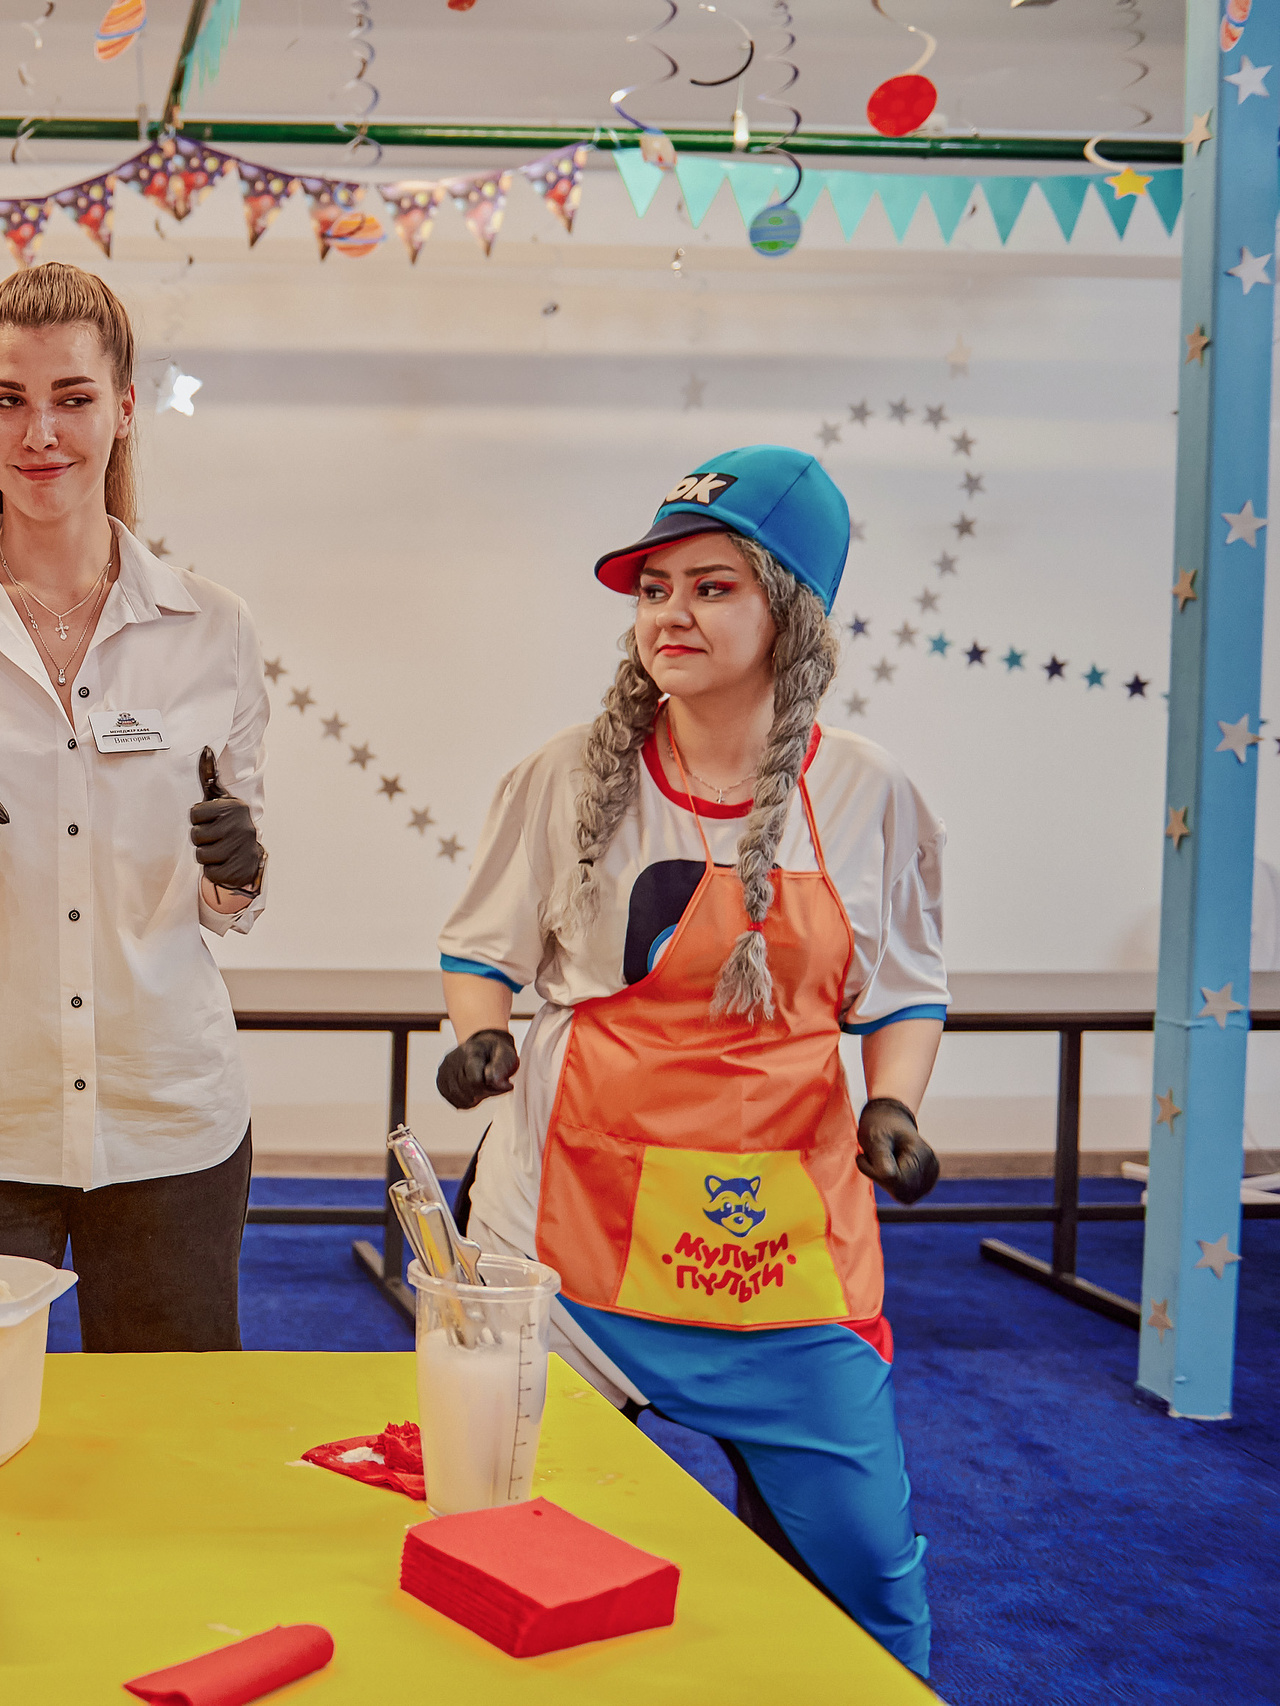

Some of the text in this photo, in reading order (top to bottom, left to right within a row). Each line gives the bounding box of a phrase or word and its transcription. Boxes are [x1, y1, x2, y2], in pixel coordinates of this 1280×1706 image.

[113, 735, 151, 744] Виктория
[674, 1231, 789, 1272] МУЛЬТИ
[676, 1262, 784, 1304] ПУЛЬТИ
